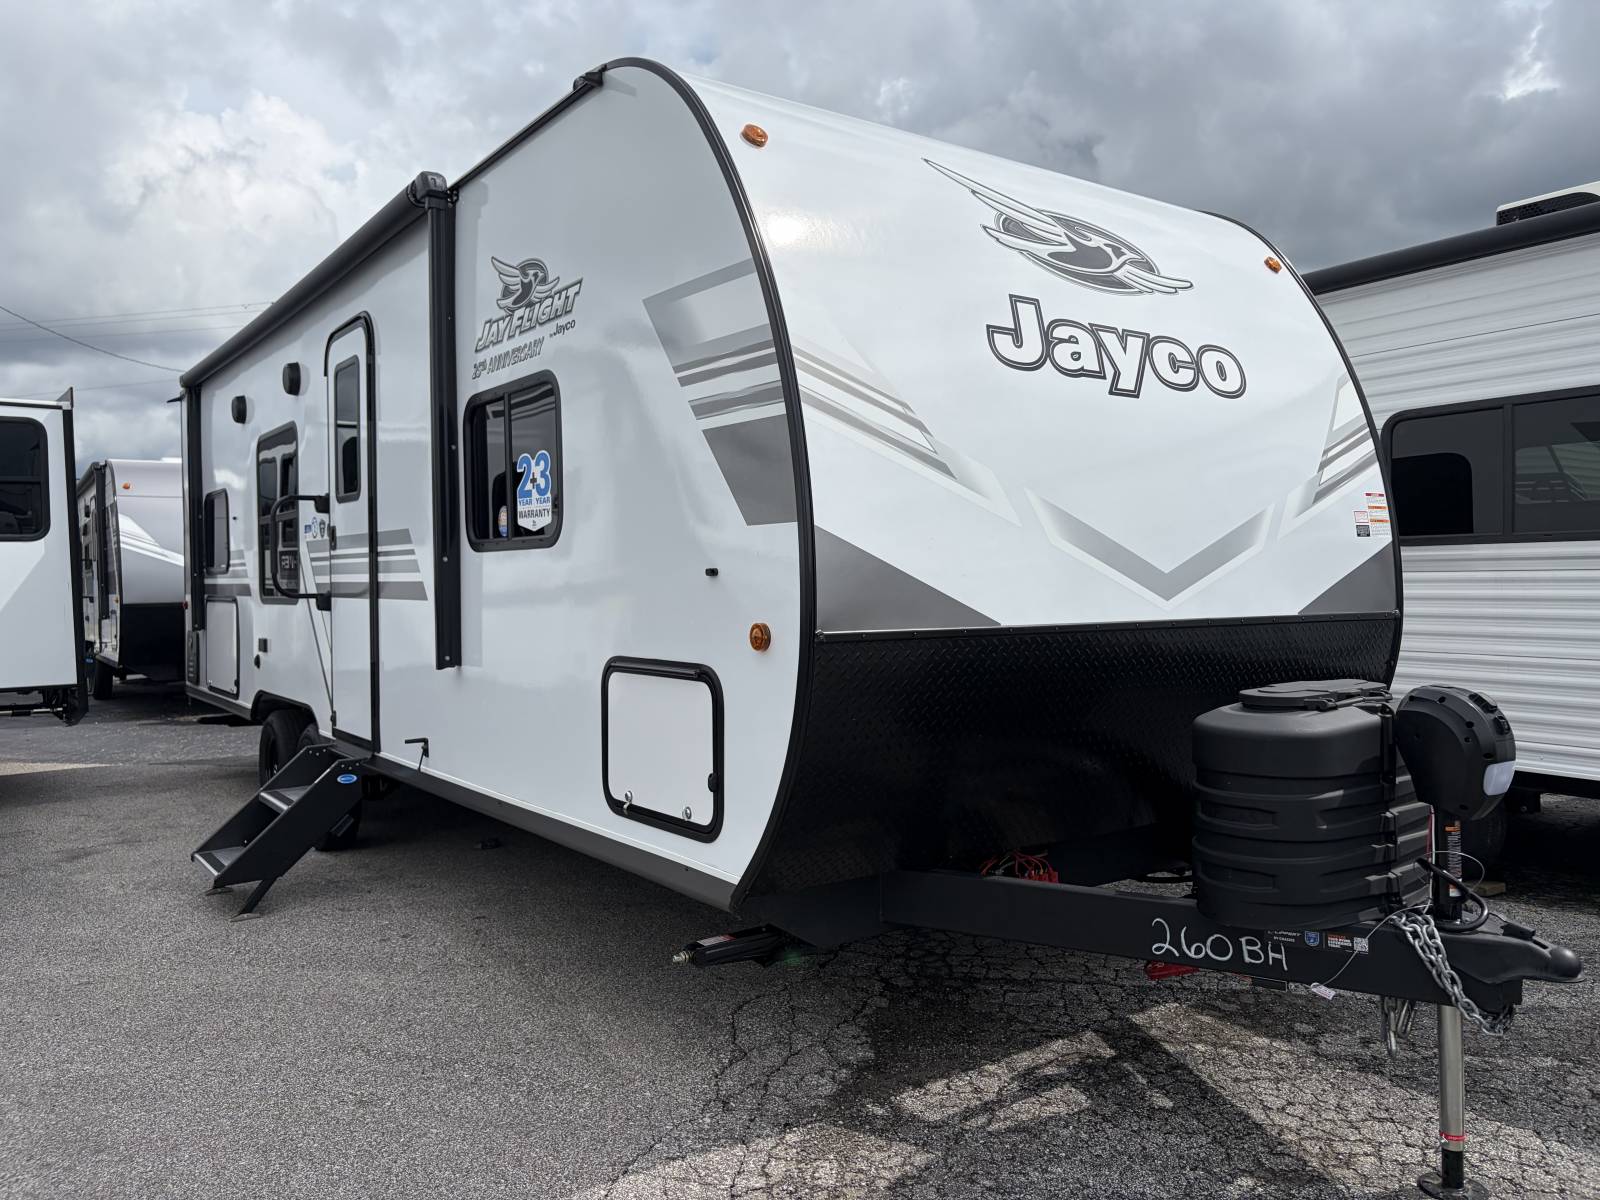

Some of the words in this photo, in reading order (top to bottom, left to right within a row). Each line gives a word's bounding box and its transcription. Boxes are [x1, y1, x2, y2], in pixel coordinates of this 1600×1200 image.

[475, 315, 513, 353] JAY
[507, 277, 583, 341] FLIGHT
[553, 319, 577, 336] Jayco
[487, 336, 545, 375] ANNIVERSARY
[986, 294, 1247, 399] Jayco
[518, 508, 551, 519] WARRANTY
[519, 498, 532, 507] YEAR
[536, 496, 550, 504] YEAR
